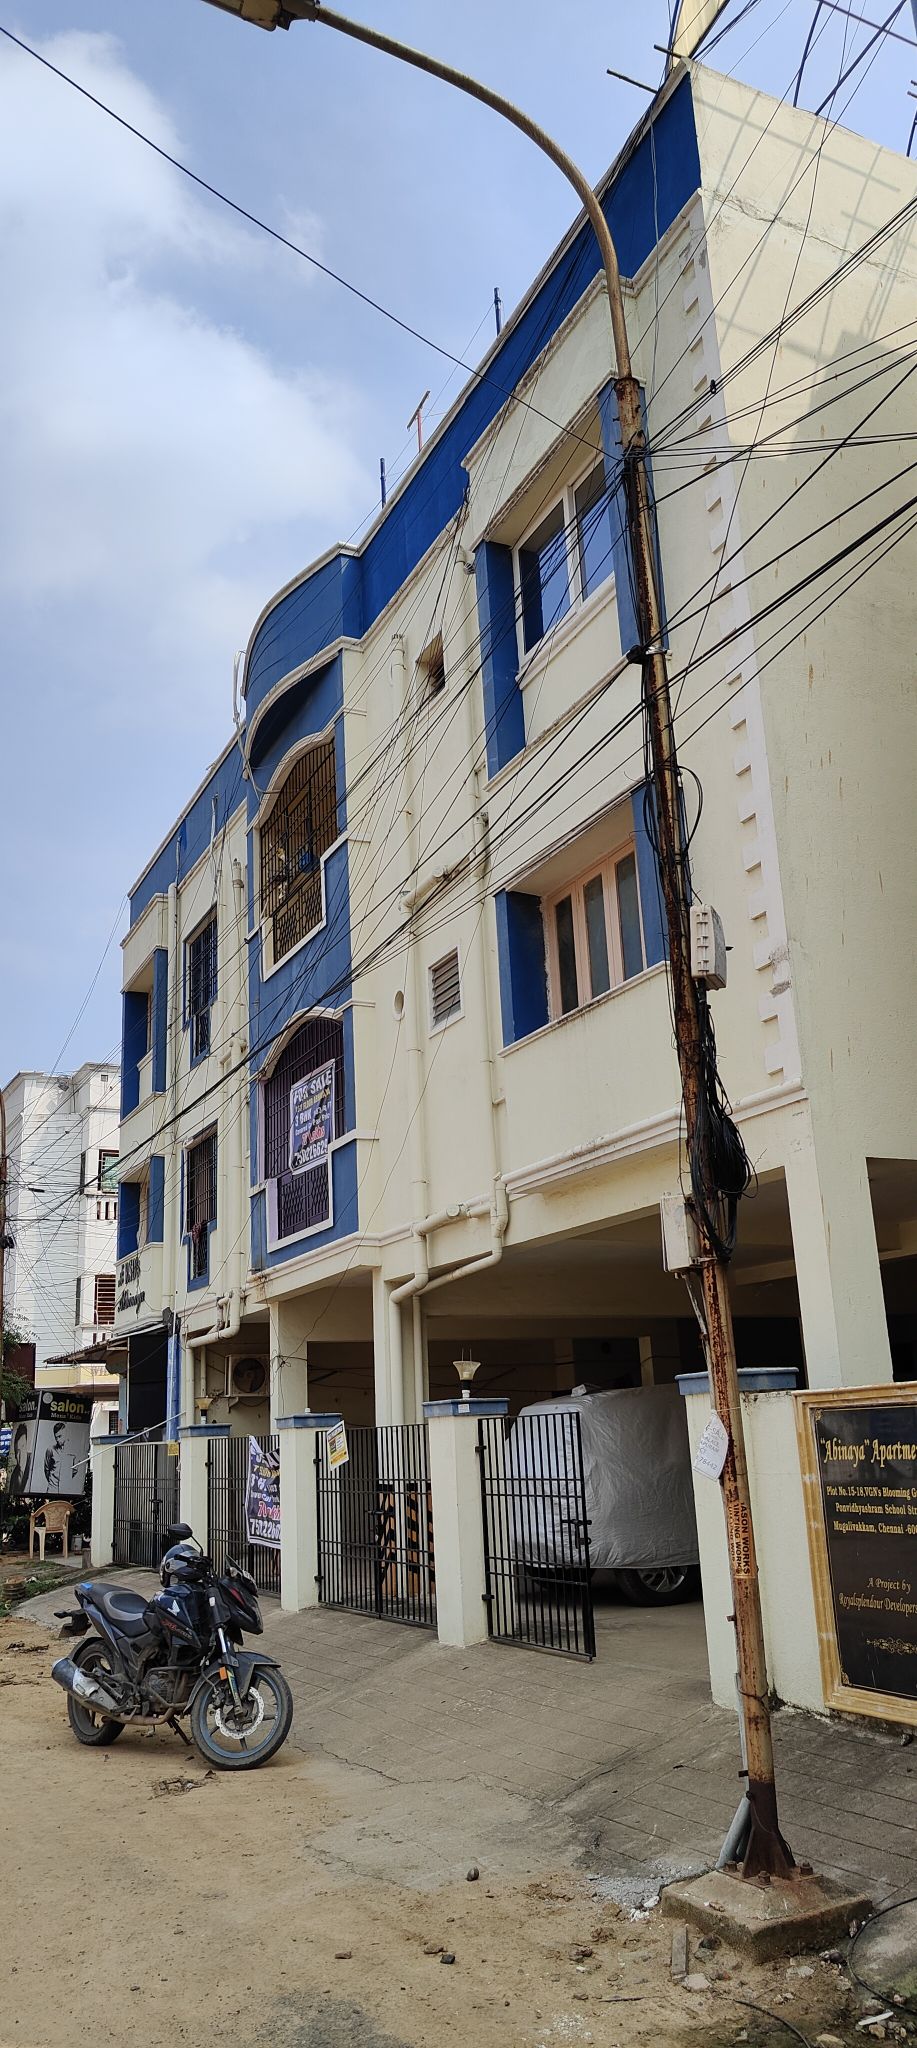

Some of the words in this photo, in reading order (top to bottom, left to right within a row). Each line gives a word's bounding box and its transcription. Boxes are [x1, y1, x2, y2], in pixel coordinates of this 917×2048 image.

[293, 1085, 309, 1104] FOR
[310, 1069, 332, 1094] SALE
[50, 1400, 85, 1413] salon
[871, 1439, 917, 1468] Apartme
[827, 1486, 838, 1496] Plot
[882, 1487, 911, 1501] Blooming
[911, 1488, 917, 1498] G
[884, 1503, 906, 1515] School
[740, 1502, 749, 1534] ASON
[878, 1522, 905, 1534] Chennai
[742, 1537, 751, 1575] WORKS
[867, 1577, 875, 1588] A
[875, 1578, 900, 1592] Project
[901, 1579, 911, 1594] by
